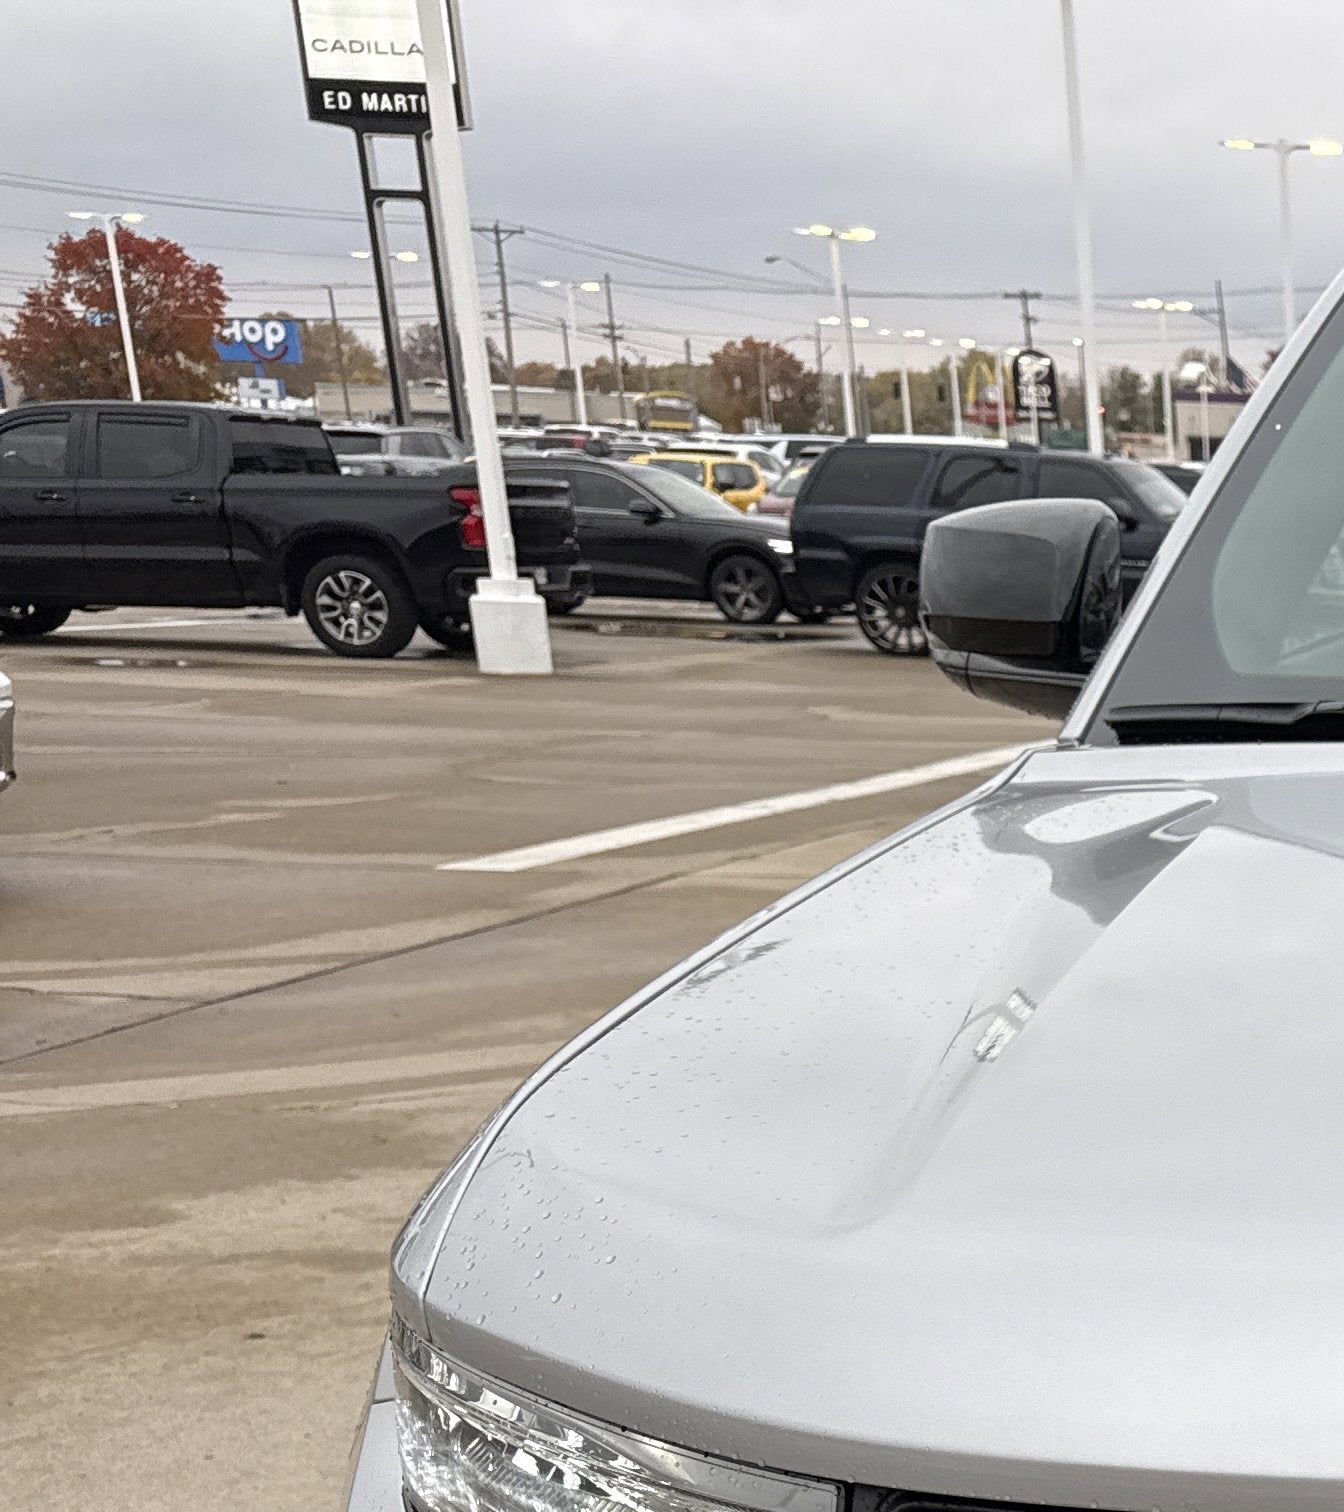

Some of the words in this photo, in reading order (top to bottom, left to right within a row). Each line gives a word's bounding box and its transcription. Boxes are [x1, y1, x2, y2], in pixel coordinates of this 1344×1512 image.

[311, 38, 424, 56] CADILLA
[322, 90, 352, 110] ED
[361, 92, 428, 114] MARTI
